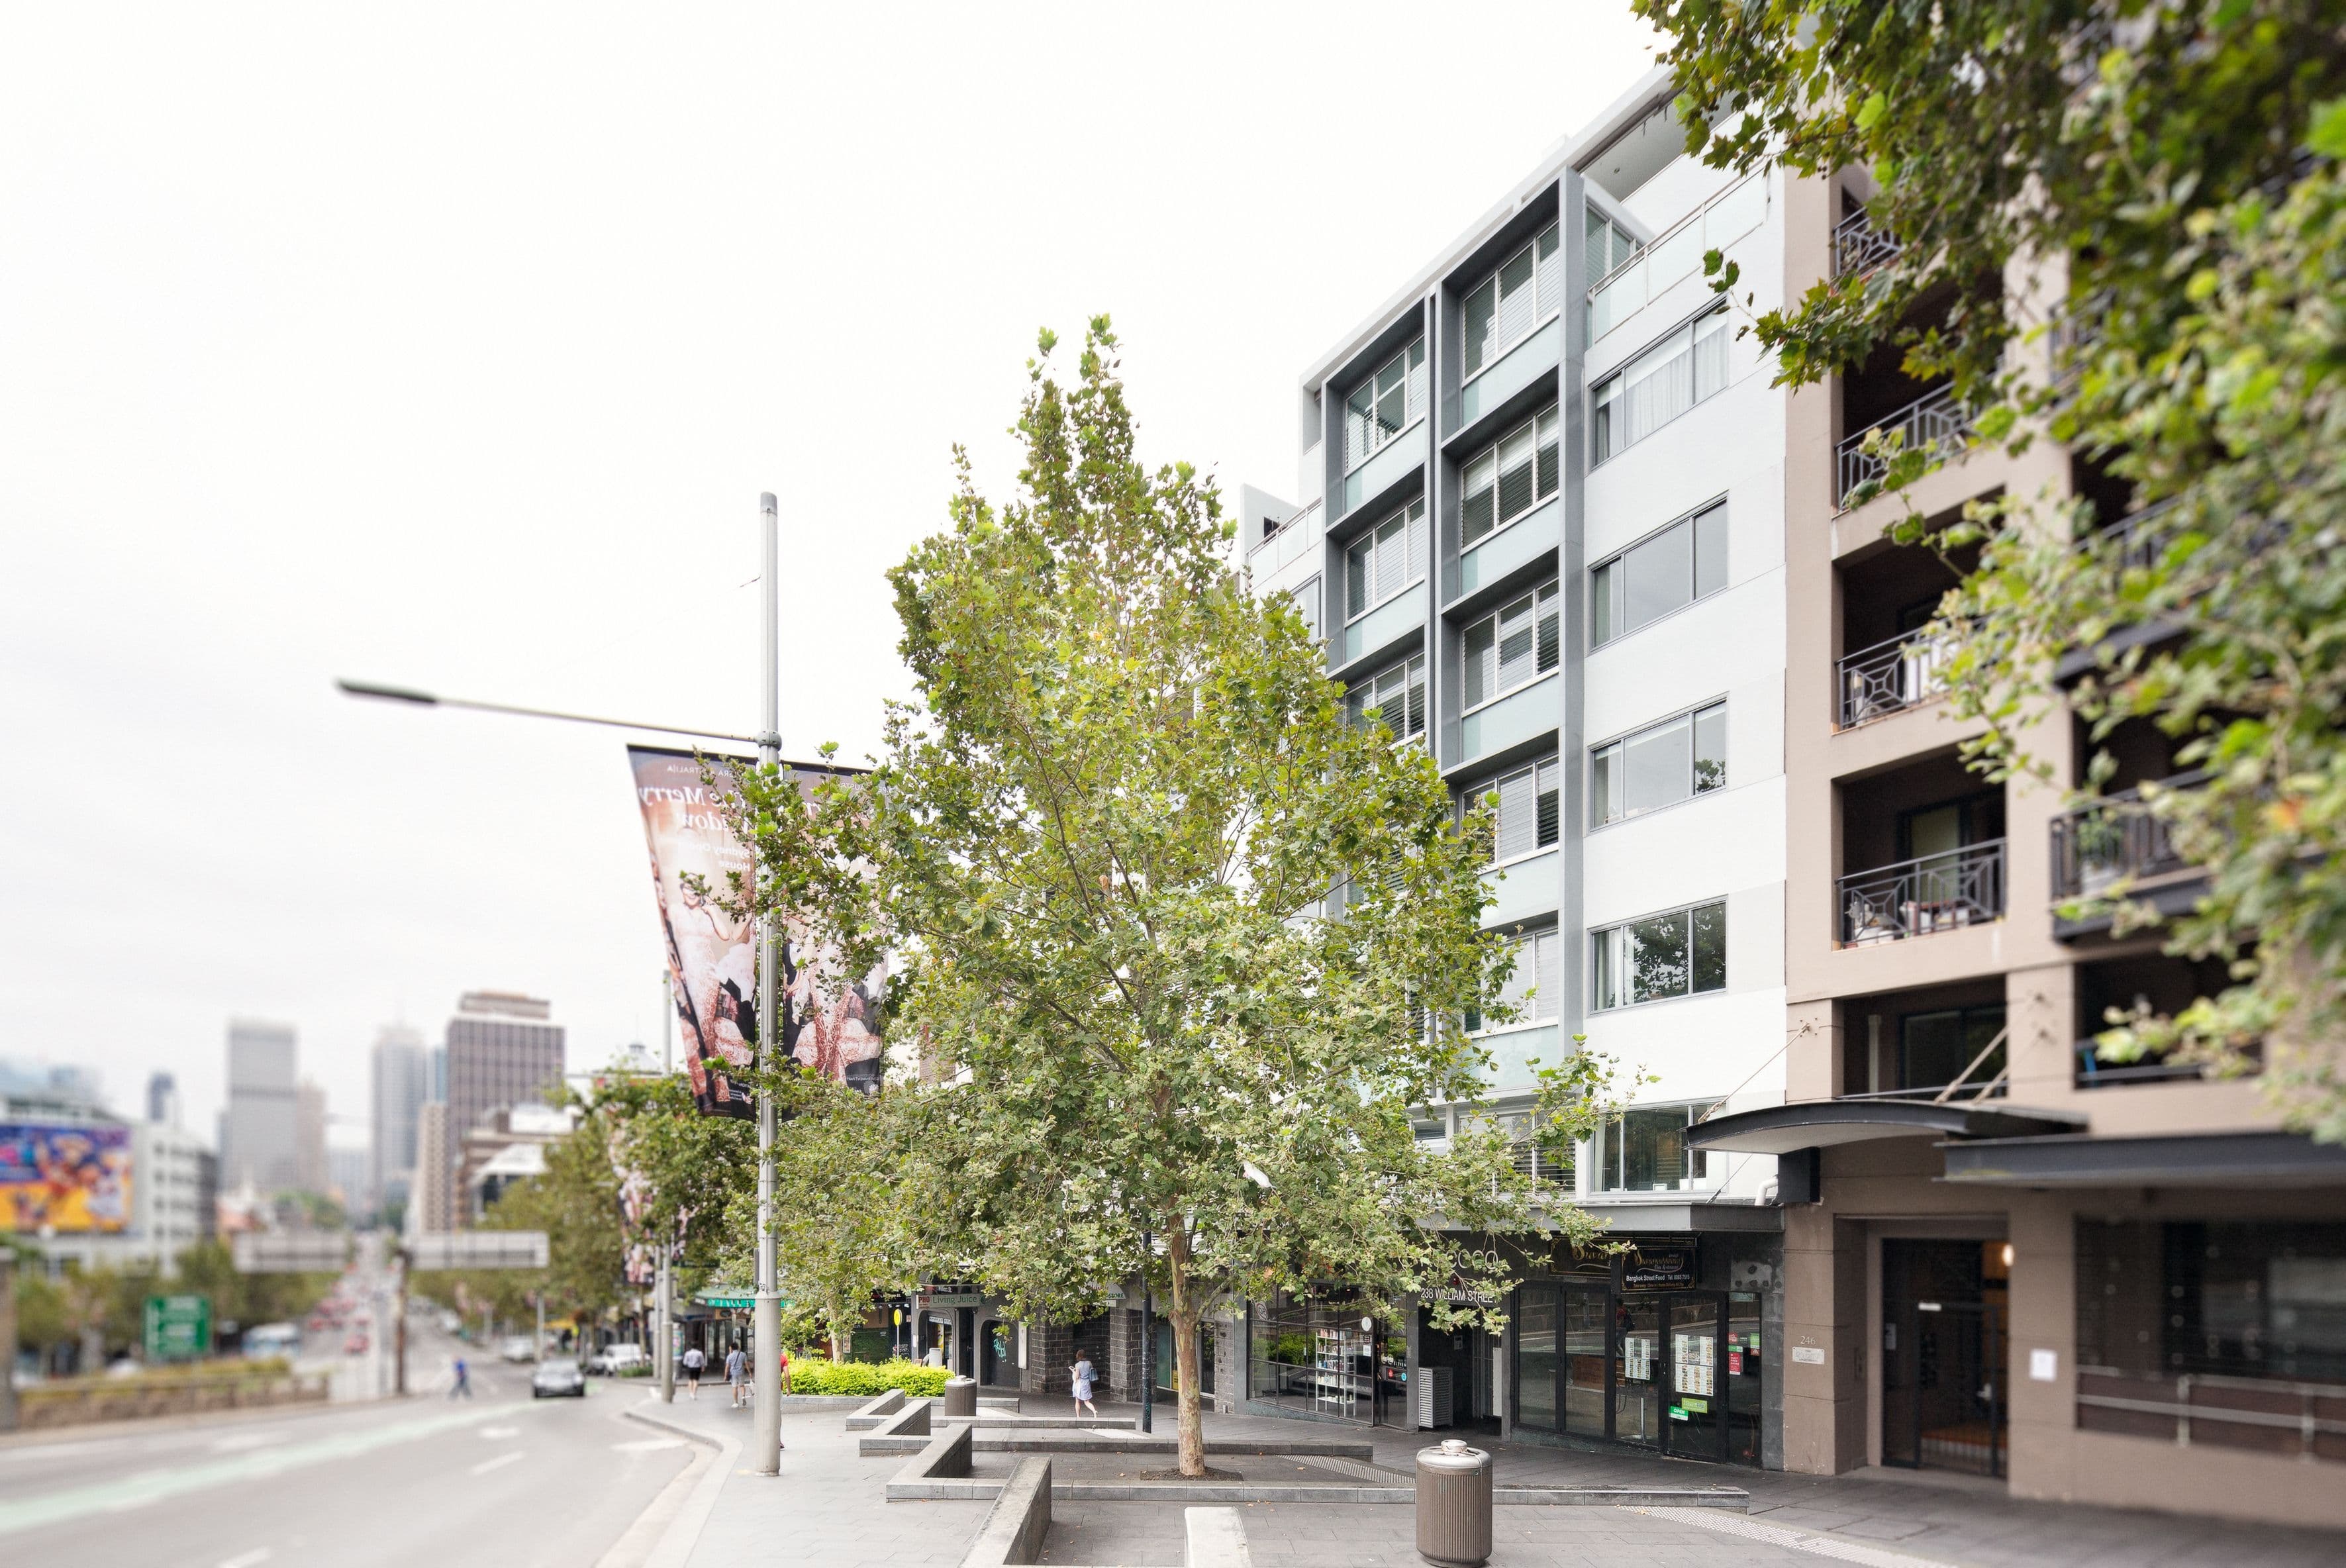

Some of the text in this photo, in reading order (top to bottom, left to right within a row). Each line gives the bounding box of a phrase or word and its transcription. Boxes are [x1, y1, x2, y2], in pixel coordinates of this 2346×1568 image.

[1420, 1287, 1434, 1299] 238
[932, 1296, 955, 1305] Living
[1800, 1336, 1816, 1345] 246
